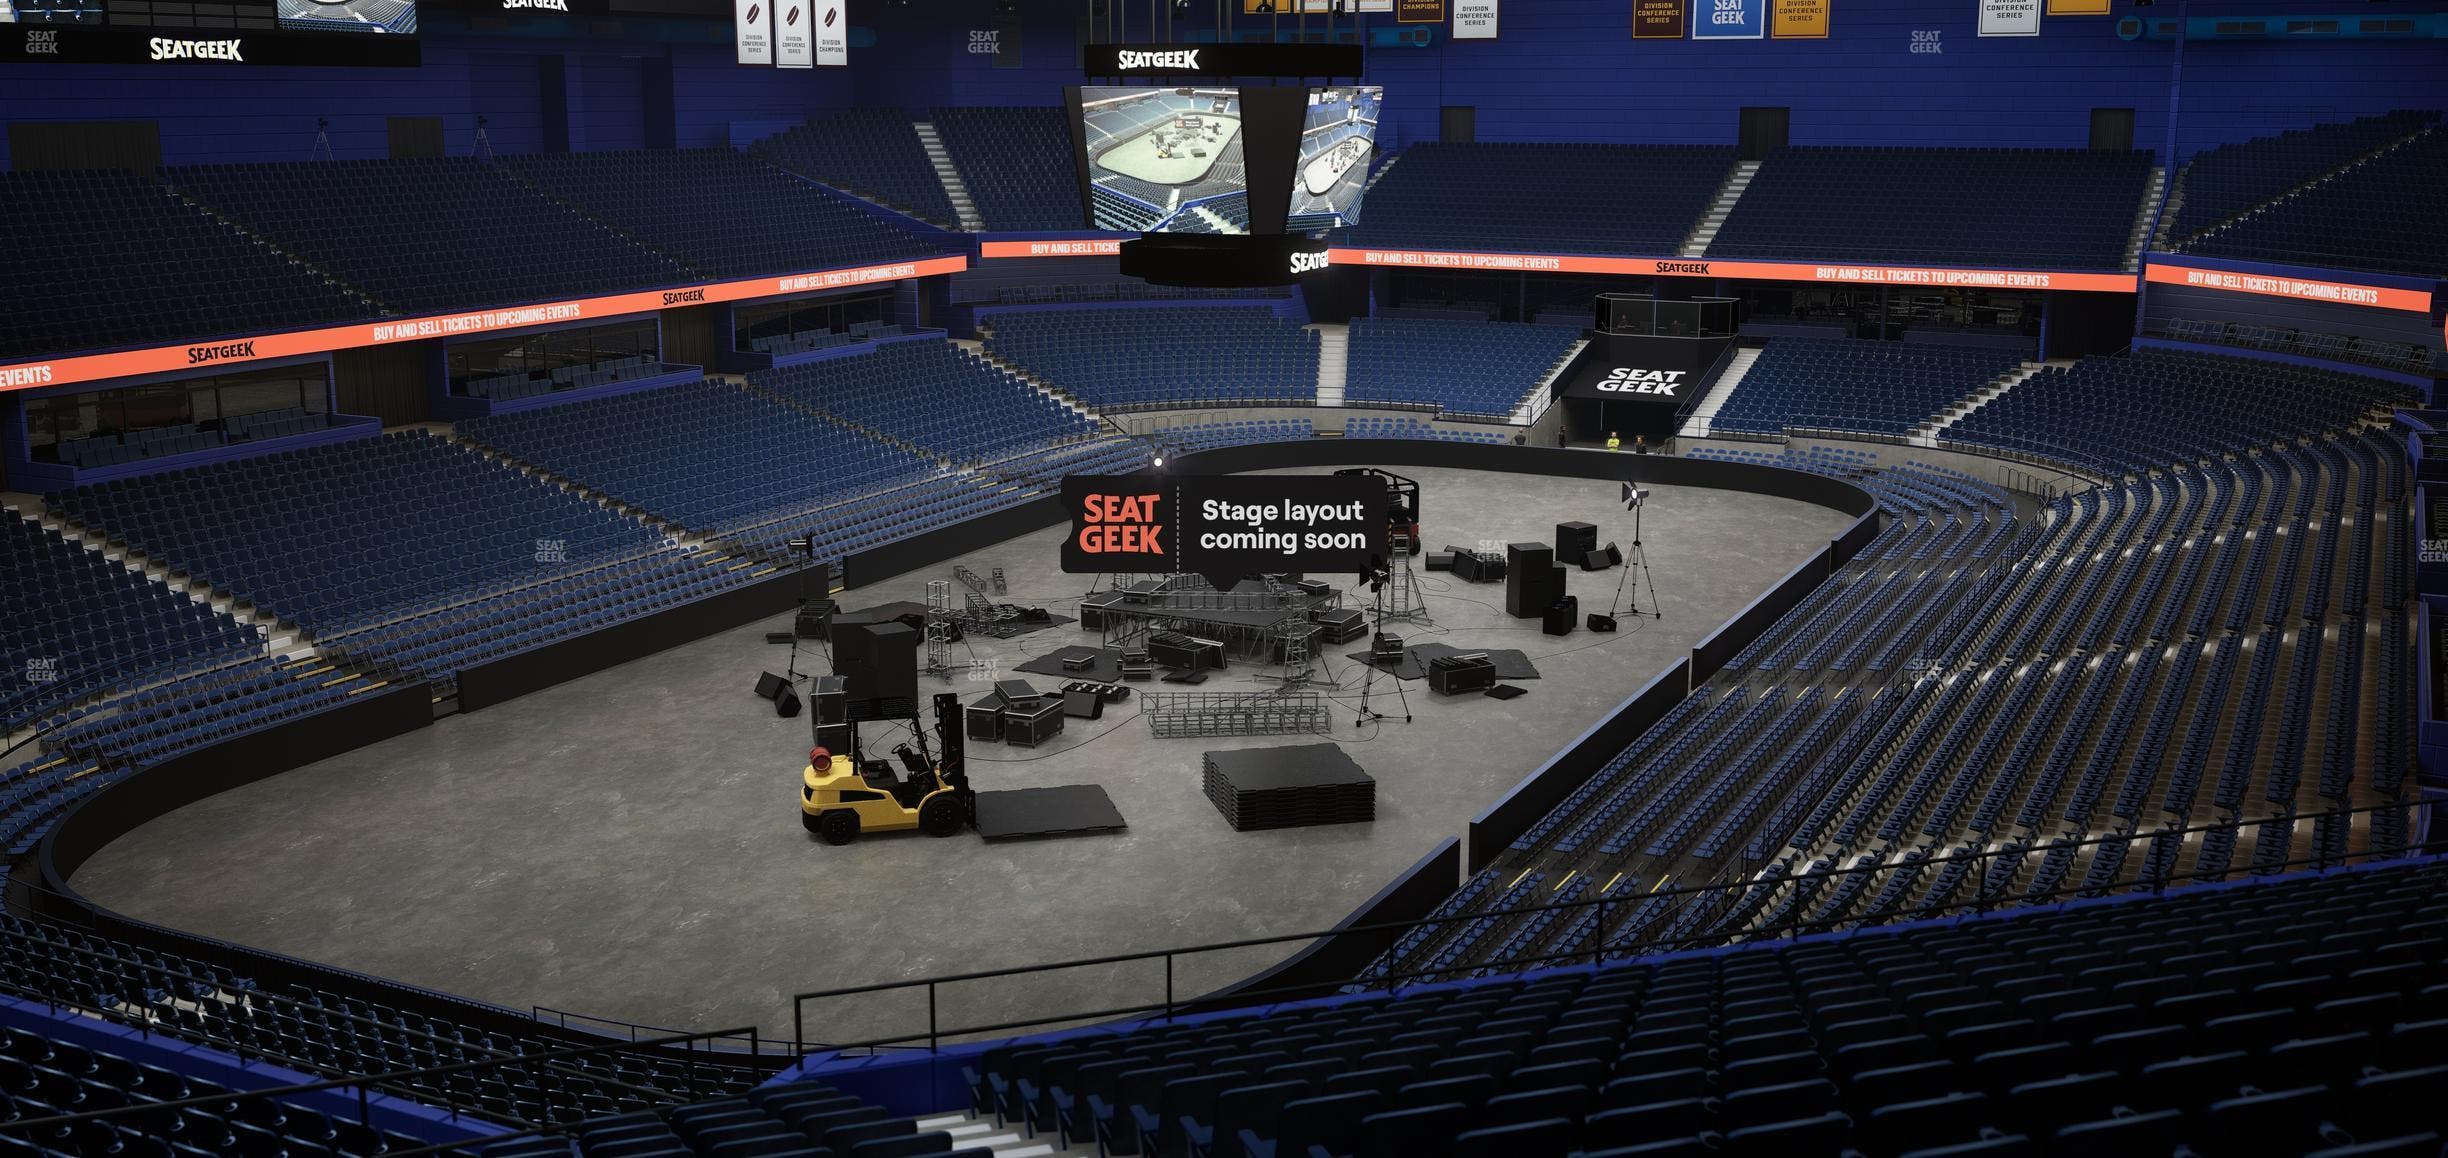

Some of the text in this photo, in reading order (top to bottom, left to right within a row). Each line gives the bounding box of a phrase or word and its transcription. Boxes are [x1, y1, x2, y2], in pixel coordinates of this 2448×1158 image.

[1714, 0, 1742, 10] SEAT
[1712, 11, 1744, 24] GEEK
[150, 38, 243, 61] SEATGEEK
[1119, 49, 1200, 70] SEATGEEK
[1032, 244, 1049, 254] BUY
[1051, 244, 1070, 253] AND
[1072, 243, 1092, 253] SELL
[1366, 253, 1559, 269] BUY AND SELL TICKETS TO UPCOMING EVENTS
[1656, 262, 1709, 275] SEATGEEK
[780, 265, 915, 291] BUY AND SELL TICKETS TO UPCOMING EVENTS
[1817, 268, 2049, 286] BUY AND SELL TICKETS TO UPCOMING EVENTS
[2188, 271, 2378, 304] BUY AND SELL TICKETS TO UPCOMING EVENTS
[663, 288, 704, 306] SEATGEEK
[374, 304, 580, 341] BUY AND SELL TICKETS TO UPCOMING EVENTS
[188, 341, 255, 364] SEATGEEK
[0, 365, 52, 386] EVENTS
[1608, 368, 1686, 382] SEAT
[1596, 380, 1681, 396] GEEK
[1084, 494, 1160, 523] SEAT
[1202, 498, 1364, 526] Stage layout
[1079, 525, 1164, 554] GEEK
[1200, 527, 1366, 555] coming soon
